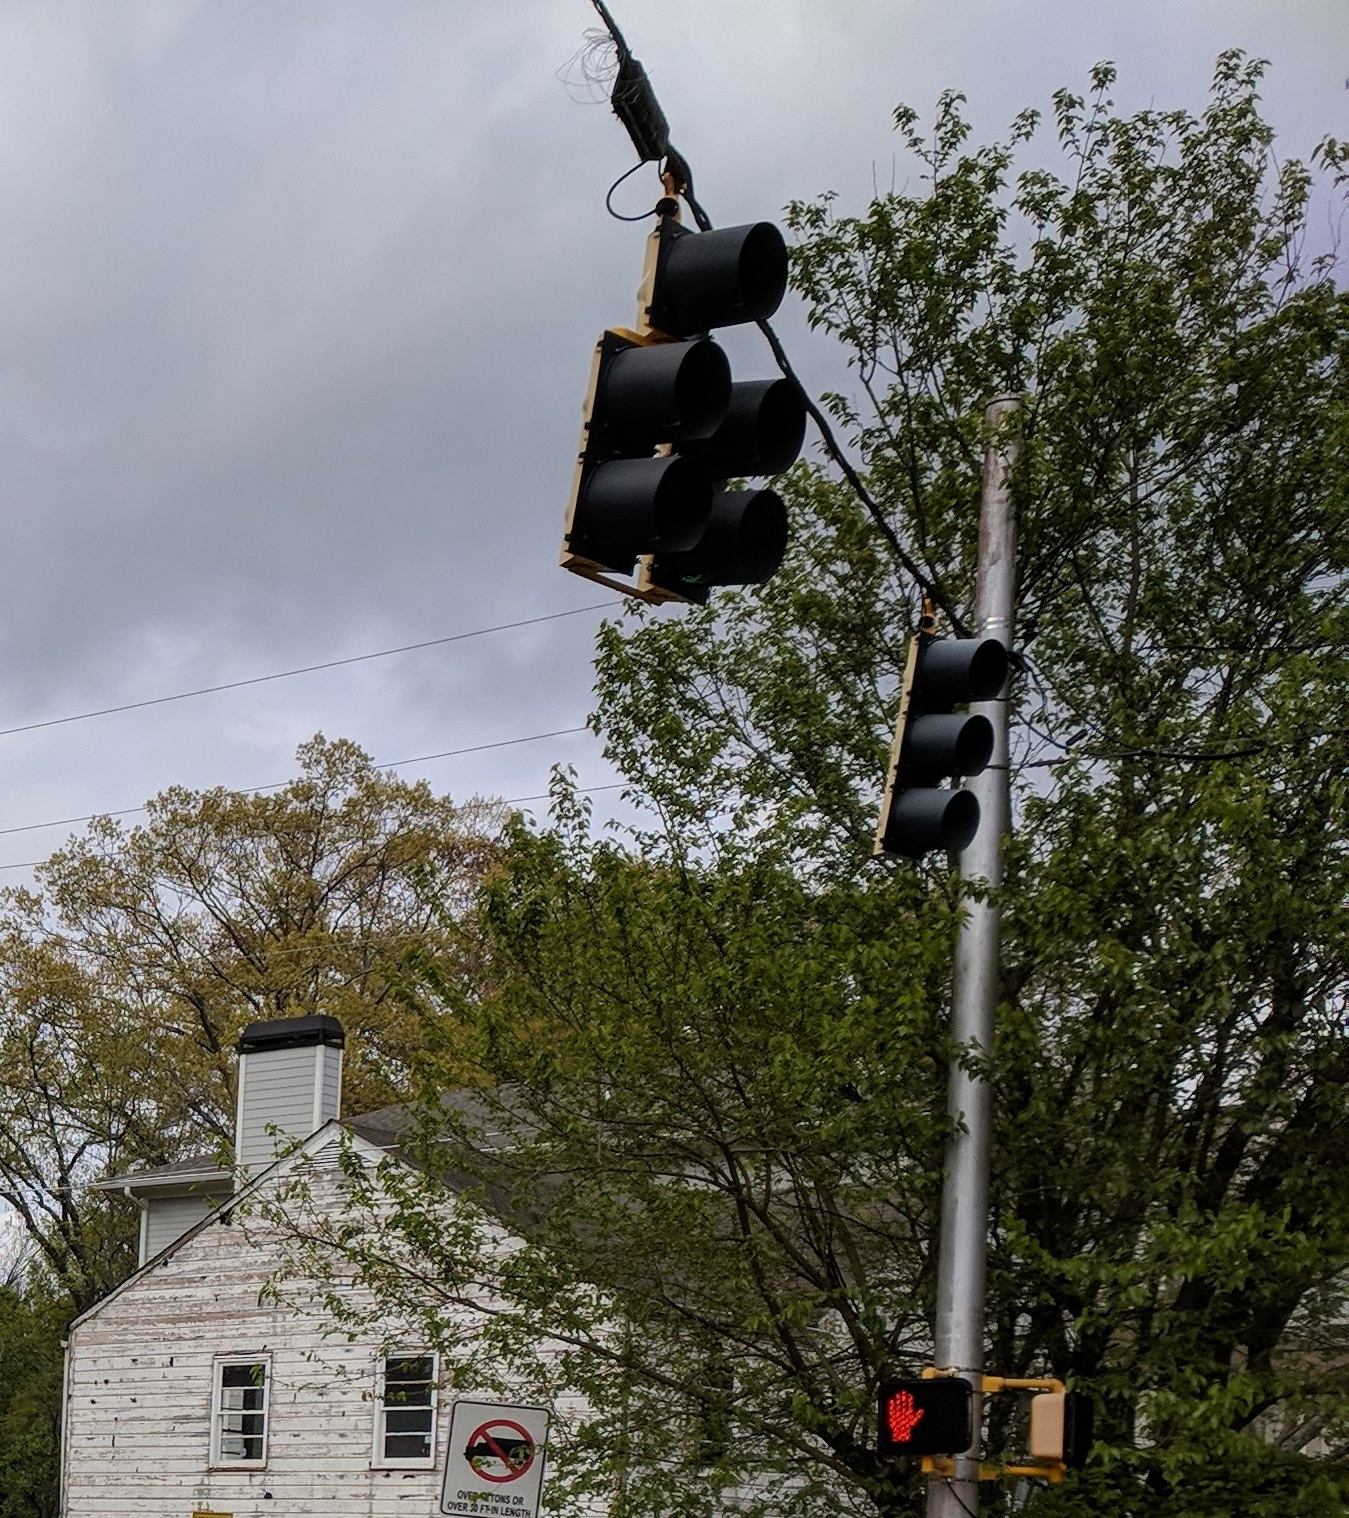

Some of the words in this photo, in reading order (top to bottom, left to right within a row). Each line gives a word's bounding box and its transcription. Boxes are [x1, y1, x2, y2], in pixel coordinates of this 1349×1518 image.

[512, 1496, 525, 1506] OR
[447, 1501, 468, 1512] OVER
[501, 1507, 532, 1518] LENGTH
